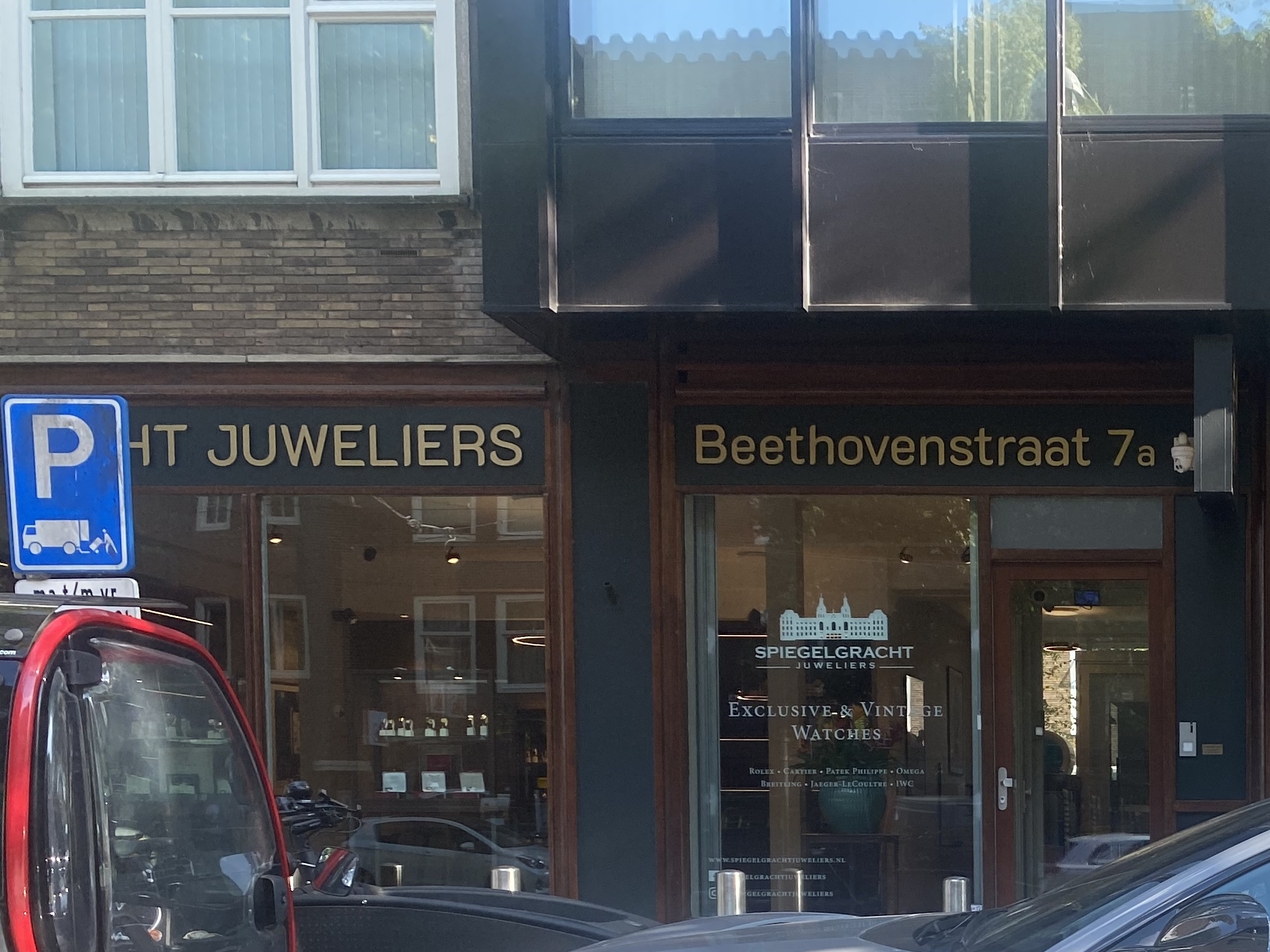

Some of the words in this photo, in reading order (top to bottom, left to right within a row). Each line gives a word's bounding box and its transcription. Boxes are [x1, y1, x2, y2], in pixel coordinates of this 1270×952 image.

[206, 423, 524, 468] JUWELIERS
[694, 423, 1091, 467] Beethovenstraat
[1106, 428, 1156, 467] 7a
[31, 413, 95, 499] P
[754, 645, 915, 659] SPIEGELGRACHT
[795, 661, 876, 670] JUWELIERS
[840, 704, 853, 718] &
[896, 780, 914, 788] IWC
